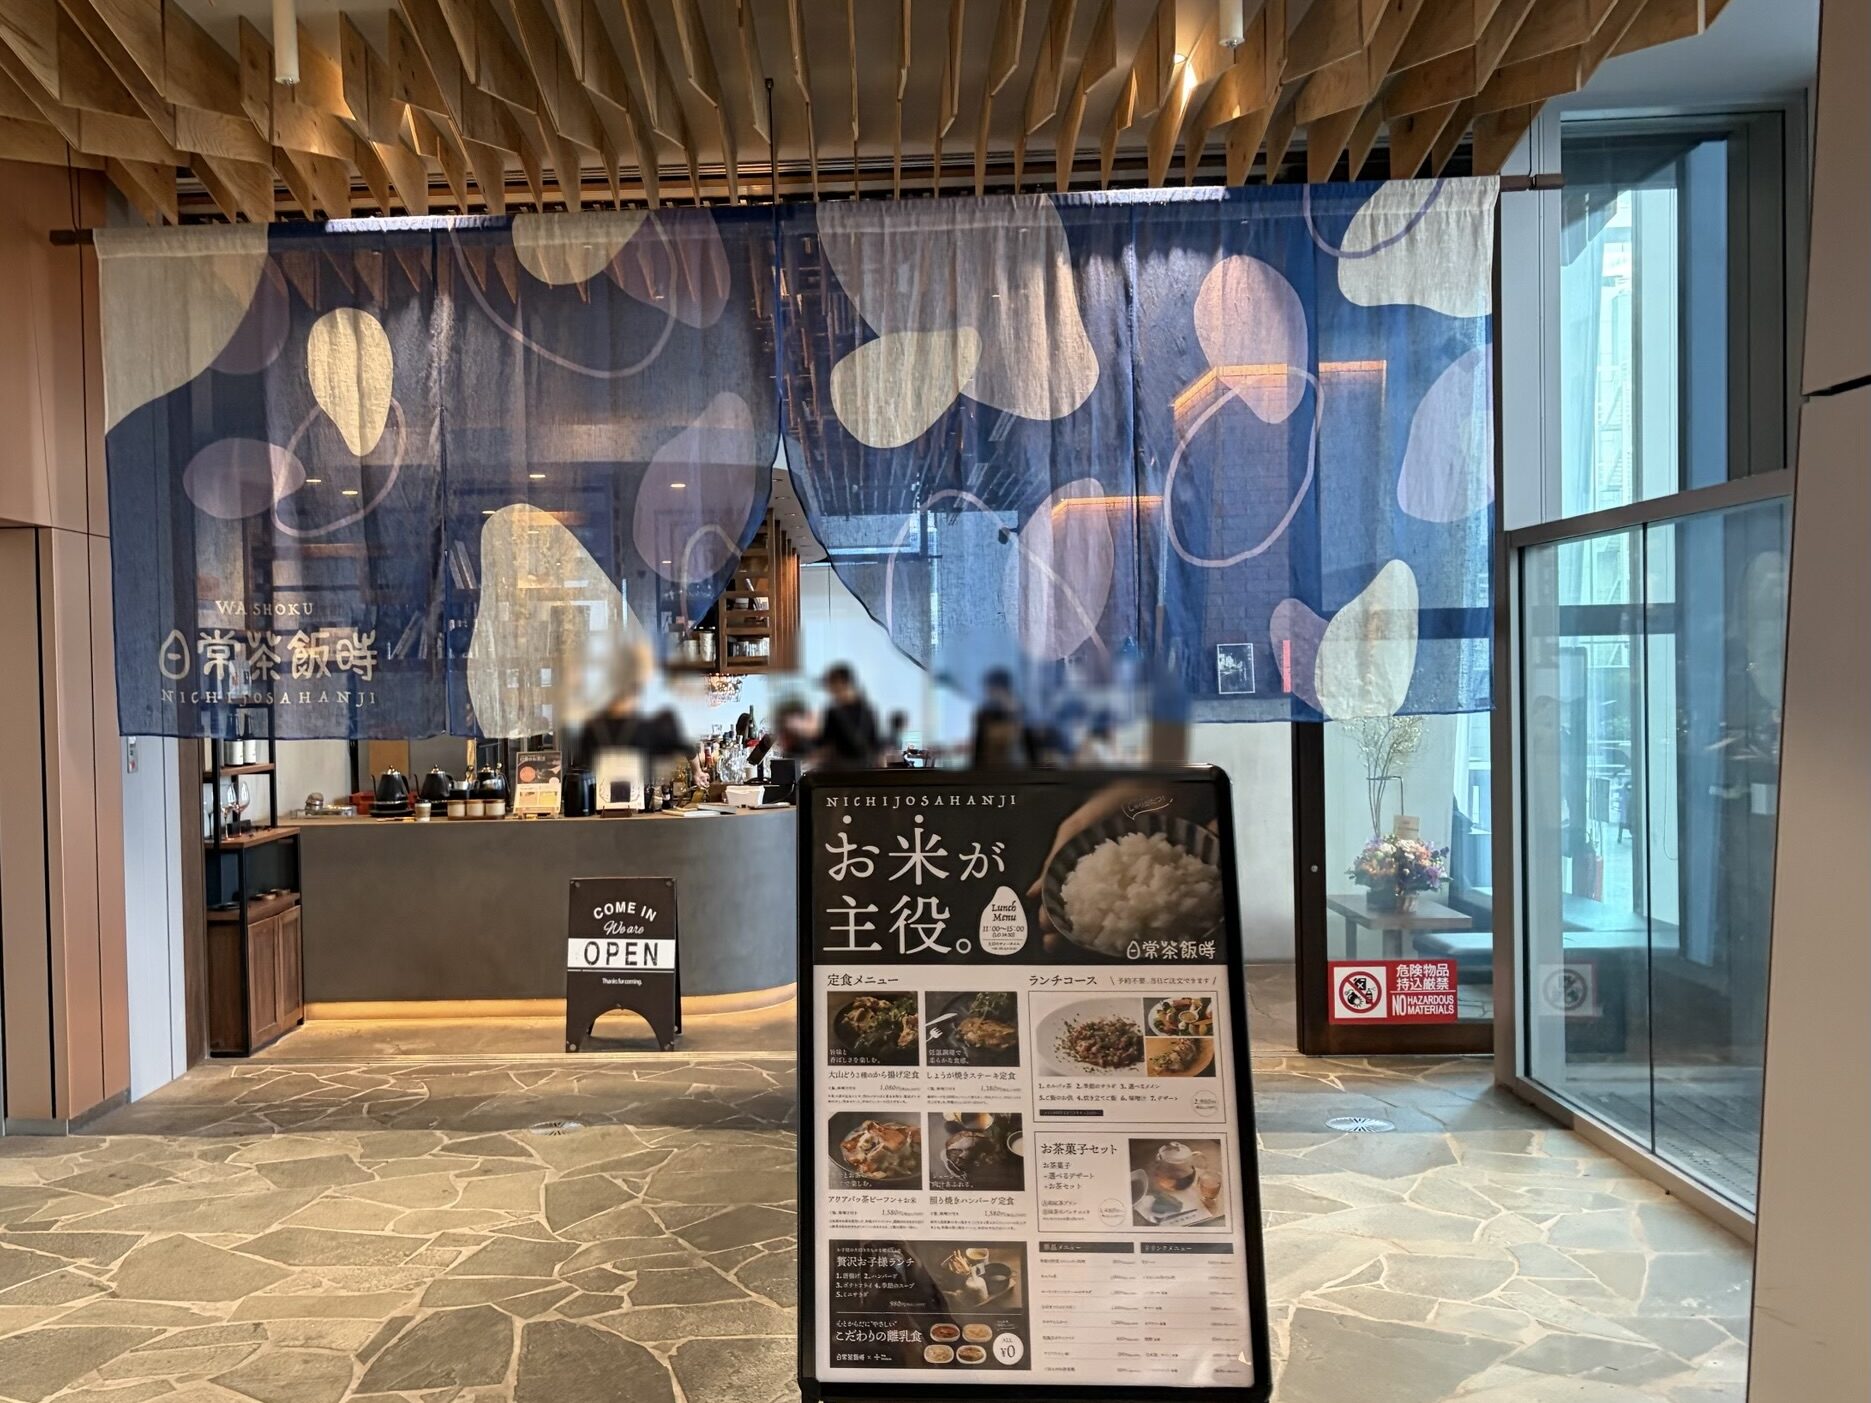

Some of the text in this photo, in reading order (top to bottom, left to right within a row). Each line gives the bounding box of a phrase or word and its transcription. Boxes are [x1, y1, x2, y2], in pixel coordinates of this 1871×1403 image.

[161, 689, 376, 708] NICHIJOSAHANJI
[826, 795, 1016, 808] NICHIJOSAHANJI
[825, 827, 1005, 885] お米が
[593, 901, 657, 922] COME IN
[992, 900, 1017, 912] Lunch
[993, 913, 1017, 921] Menu
[603, 920, 644, 935] We are
[823, 895, 971, 954] 主役。
[584, 941, 658, 966] OPEN
[1396, 964, 1449, 977] 危険物品
[827, 973, 899, 987] 定食メニュー
[1029, 975, 1097, 986] ランチコース
[1397, 978, 1449, 990] 持込厳禁
[1392, 995, 1454, 1016] NO HAZARDOUS
[1408, 1005, 1454, 1014] MATERIALS
[1041, 1143, 1117, 1155] お茶菓子セット
[836, 1329, 922, 1342] こだわりの離乳食
